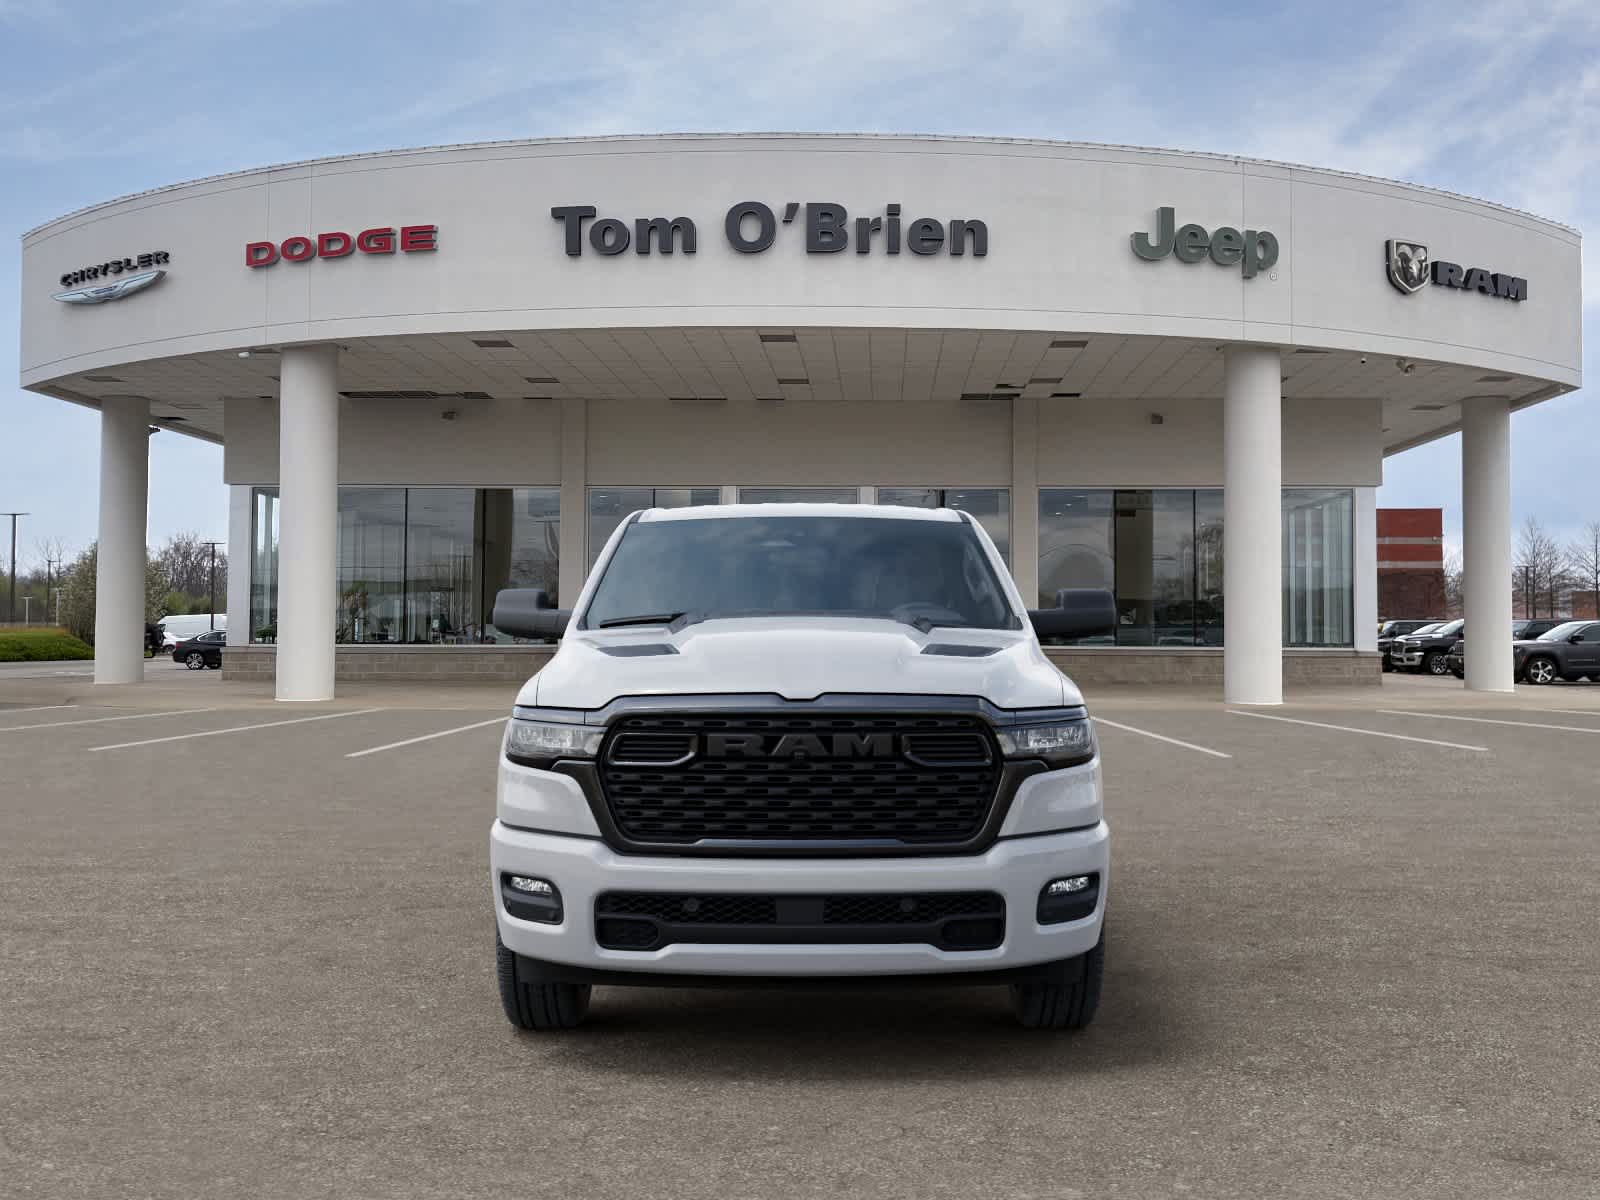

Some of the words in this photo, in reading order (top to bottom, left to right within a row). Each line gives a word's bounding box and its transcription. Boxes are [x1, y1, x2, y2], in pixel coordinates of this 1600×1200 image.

[245, 224, 438, 269] DODGE
[551, 205, 696, 256] Tom
[724, 201, 988, 256] O'Brien
[1129, 206, 1280, 279] Jeep
[59, 250, 170, 287] CHRYSLER
[1430, 260, 1528, 302] RAM
[706, 732, 894, 758] RAM
